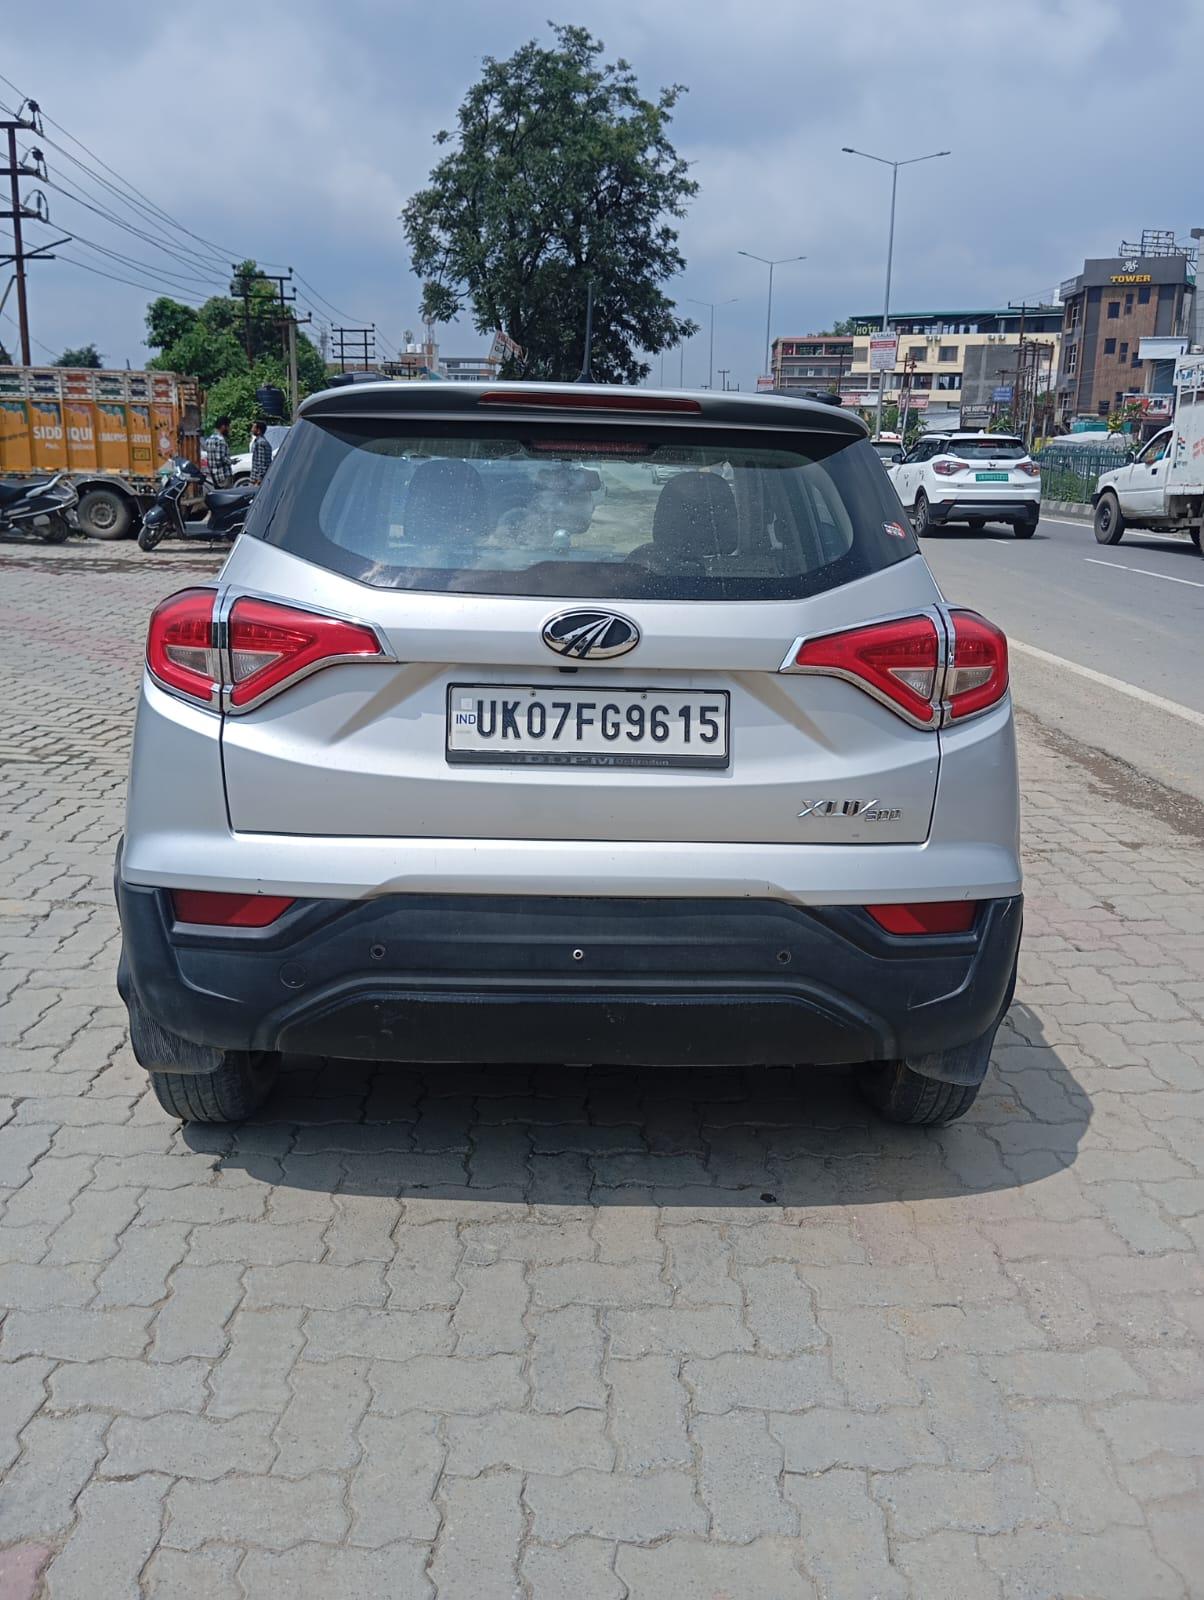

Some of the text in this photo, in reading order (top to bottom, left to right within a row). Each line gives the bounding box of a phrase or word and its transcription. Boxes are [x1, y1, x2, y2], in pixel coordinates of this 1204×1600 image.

[1110, 274, 1151, 283] TOWER
[456, 700, 719, 743] IND UK07FG9615
